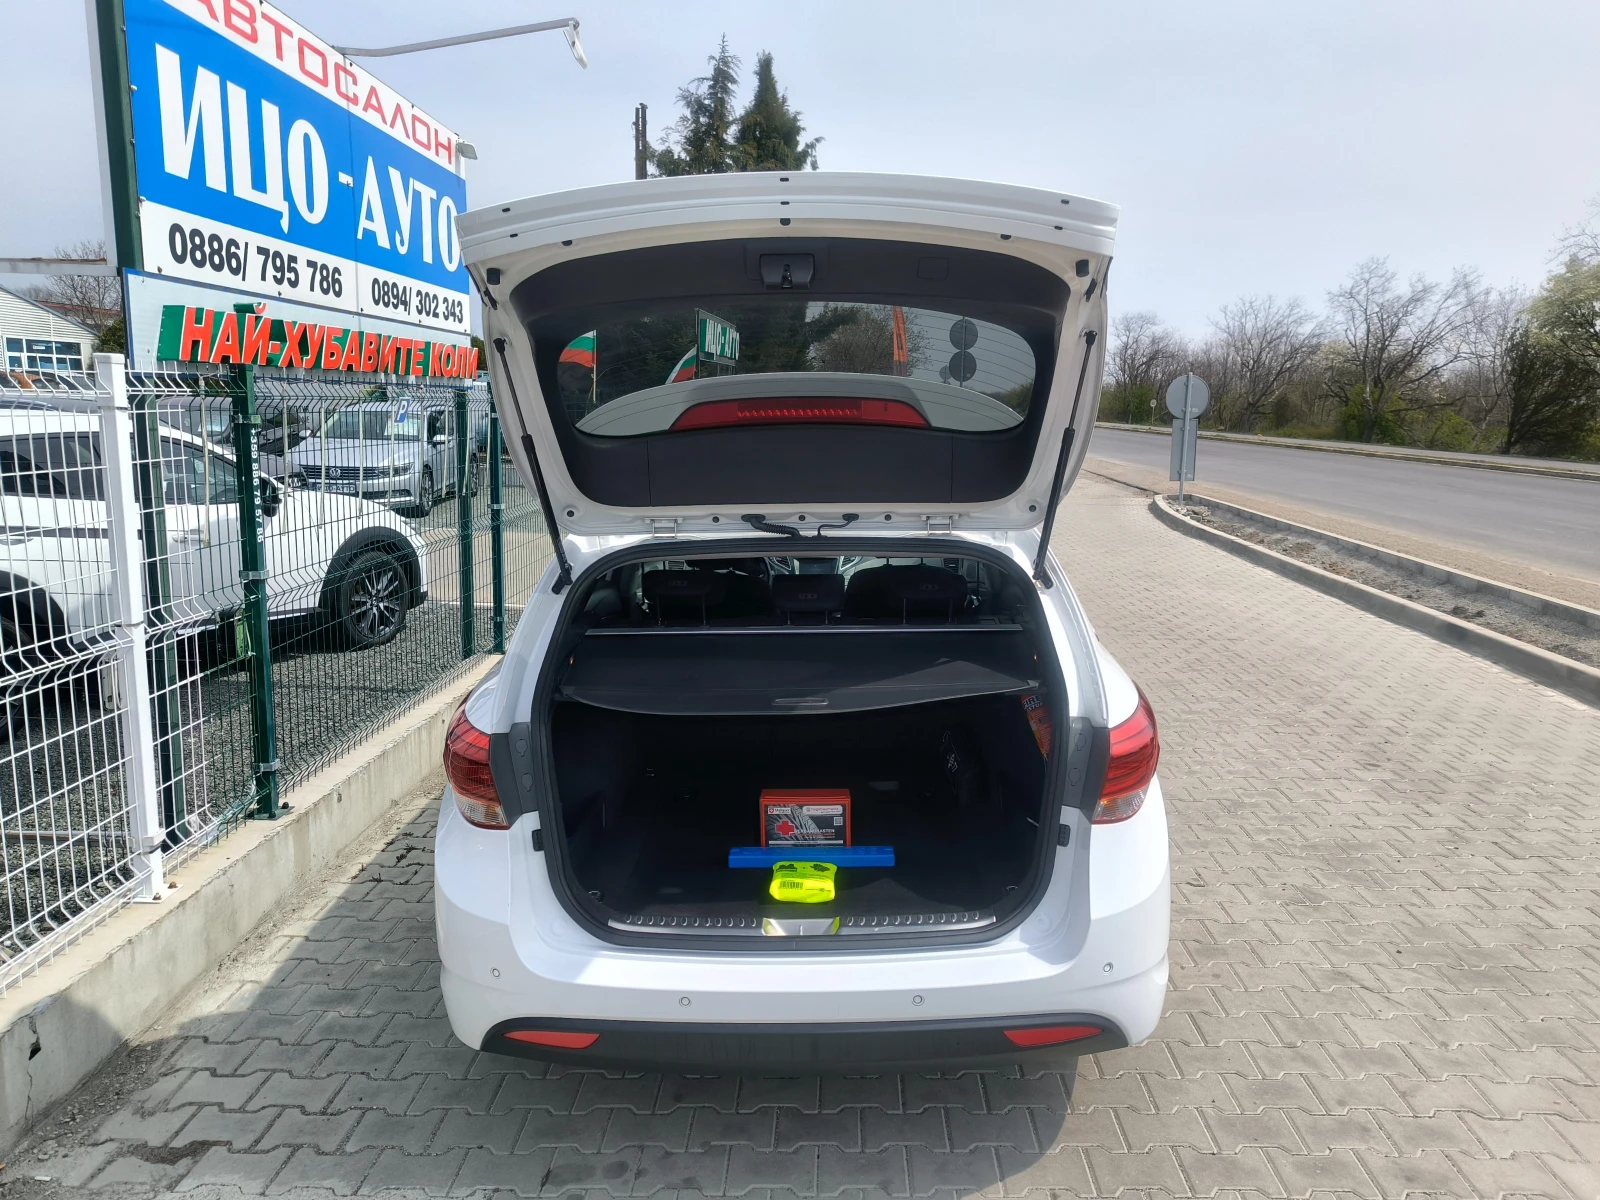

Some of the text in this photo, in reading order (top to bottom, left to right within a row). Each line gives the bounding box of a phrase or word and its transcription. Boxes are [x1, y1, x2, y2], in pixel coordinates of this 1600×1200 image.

[168, 223, 343, 298] 0886/ 795 786
[371, 277, 464, 324] 0894/ 302 343
[180, 302, 479, 380] НАЙ-ХУБАВИТЕ КОЛИ
[250, 427, 264, 543] +359 886 79 57 86
